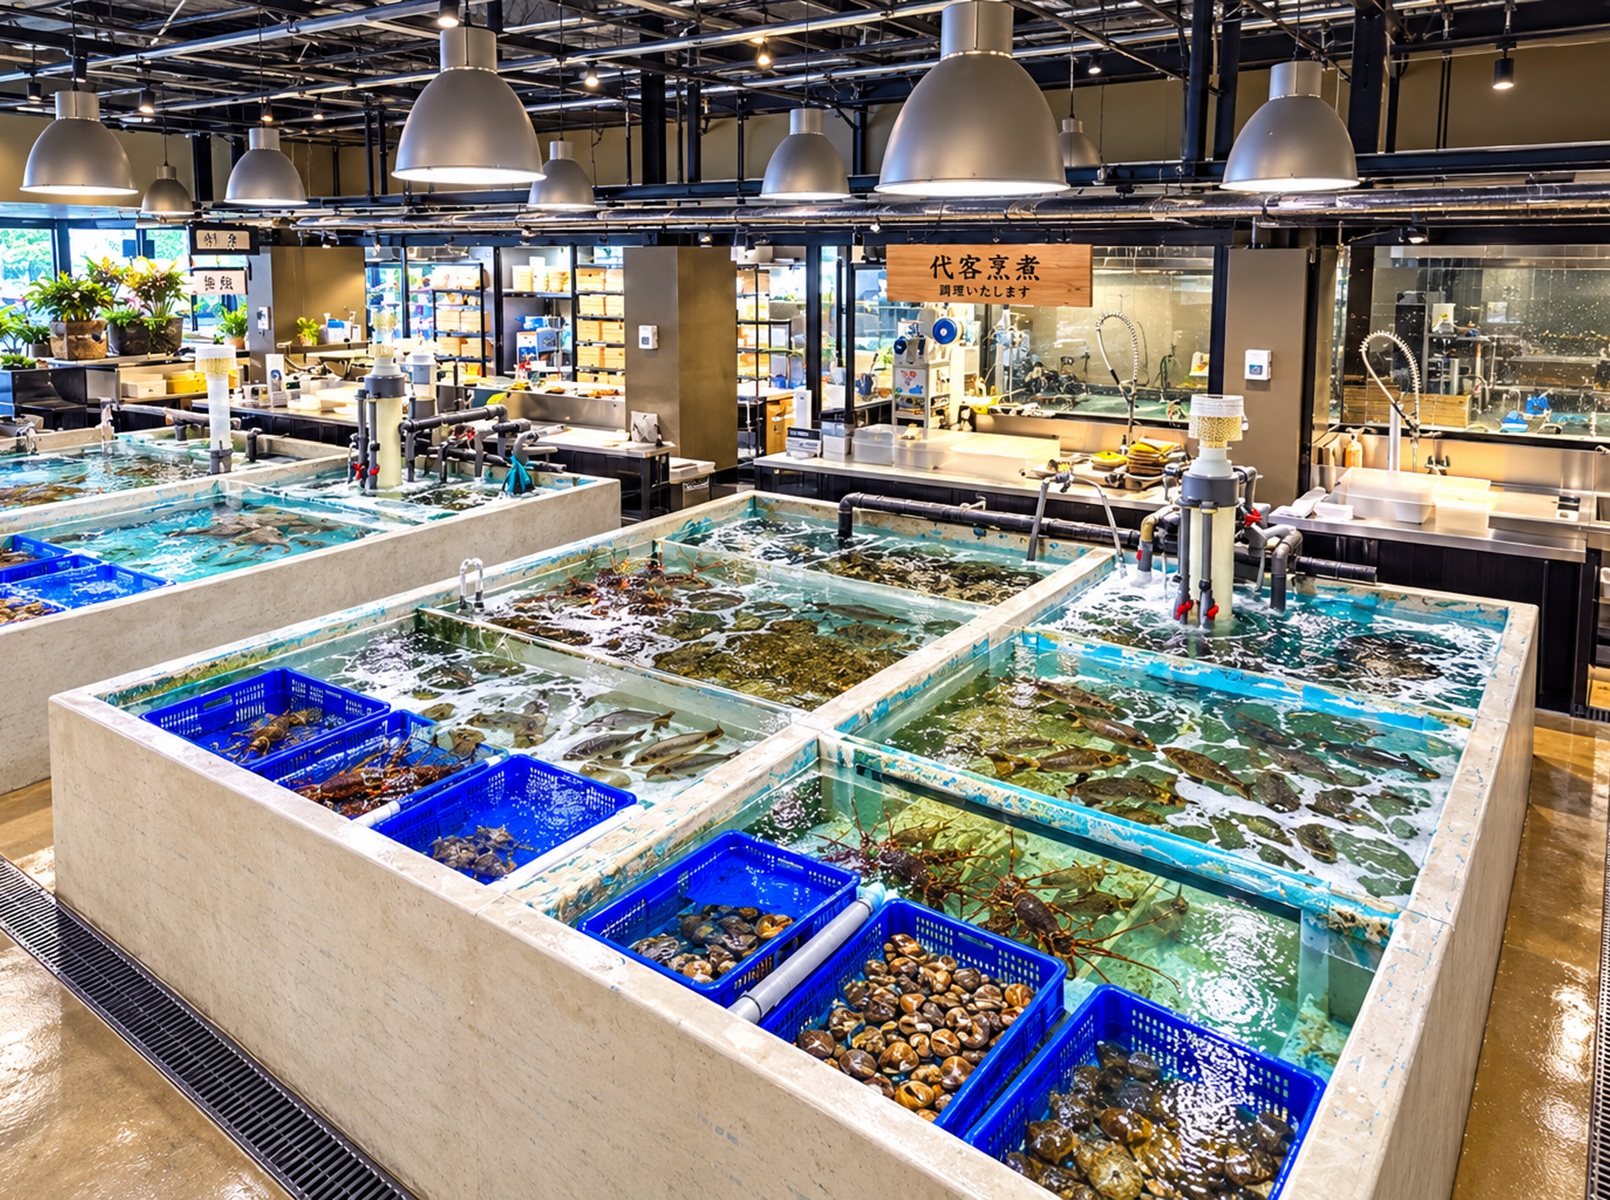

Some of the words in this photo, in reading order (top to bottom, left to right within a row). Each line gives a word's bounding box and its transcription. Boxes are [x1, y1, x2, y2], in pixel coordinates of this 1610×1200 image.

[929, 254, 1040, 281] 代客烹煮
[939, 284, 1031, 299] 調理いたします
